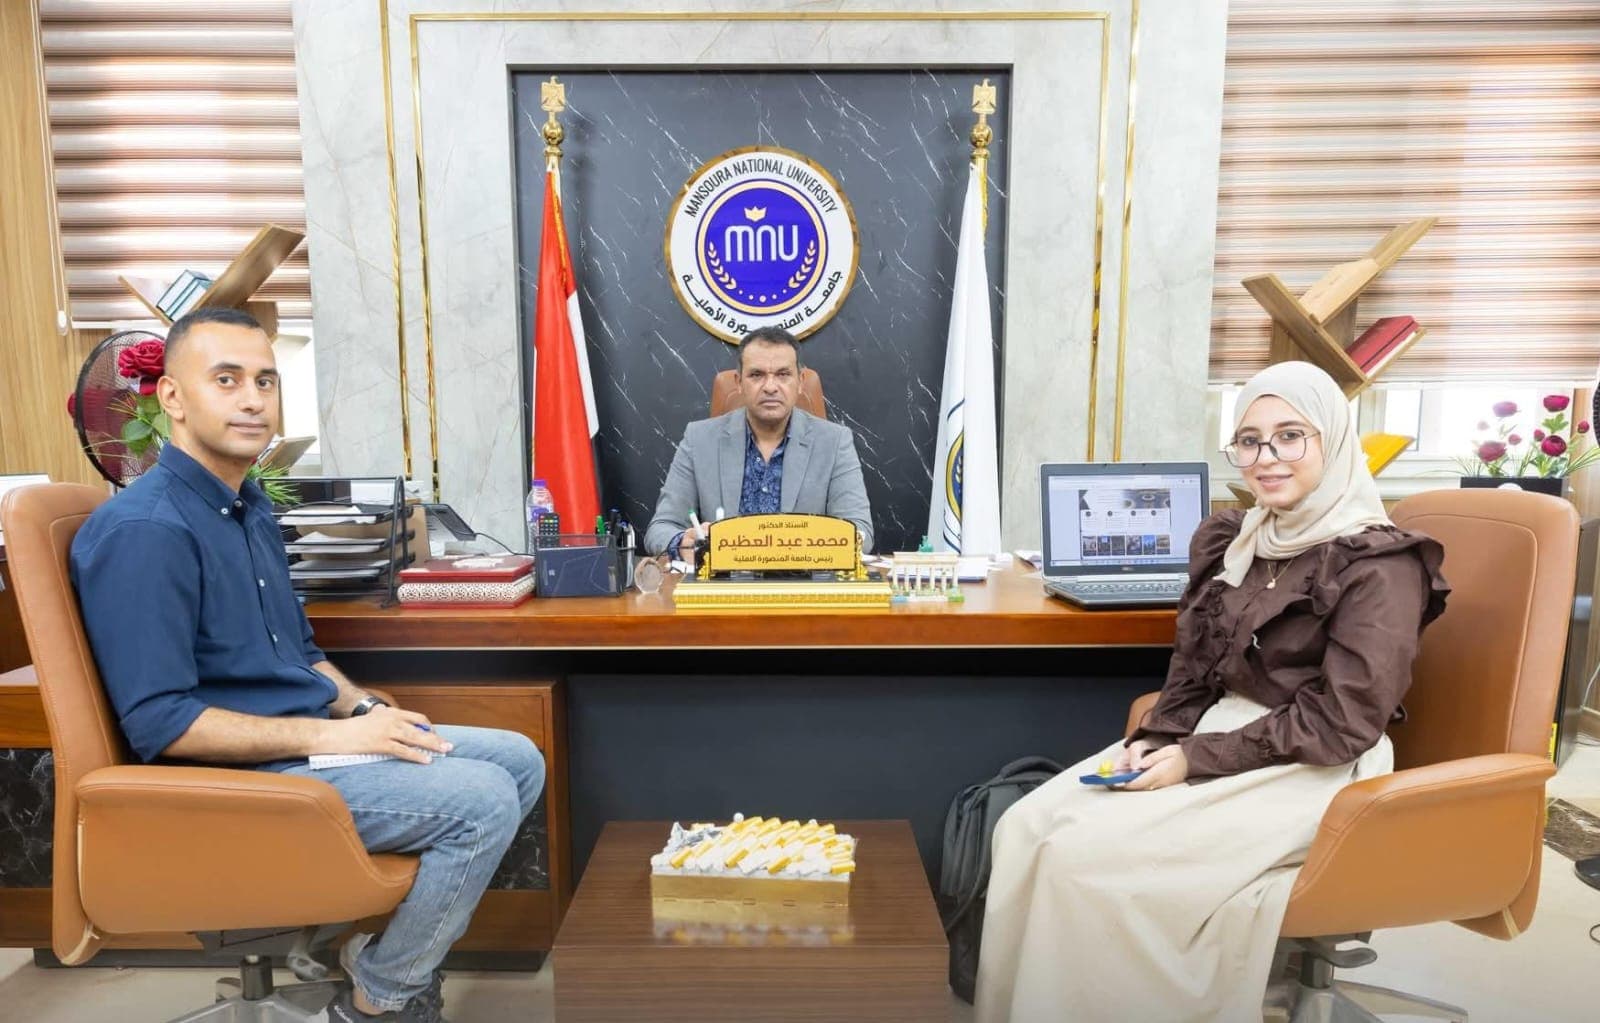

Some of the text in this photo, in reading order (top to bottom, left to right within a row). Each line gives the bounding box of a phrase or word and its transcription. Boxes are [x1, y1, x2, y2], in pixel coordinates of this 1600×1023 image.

[684, 158, 838, 218] MANSOURA NATIONAL UNIVERSITY
[758, 521, 783, 531] الدكتور
[718, 534, 849, 551] محمد عبد العظيم
[757, 554, 790, 564] المنصورة
[790, 554, 812, 562] جامعة
[813, 555, 834, 564] رئيس
